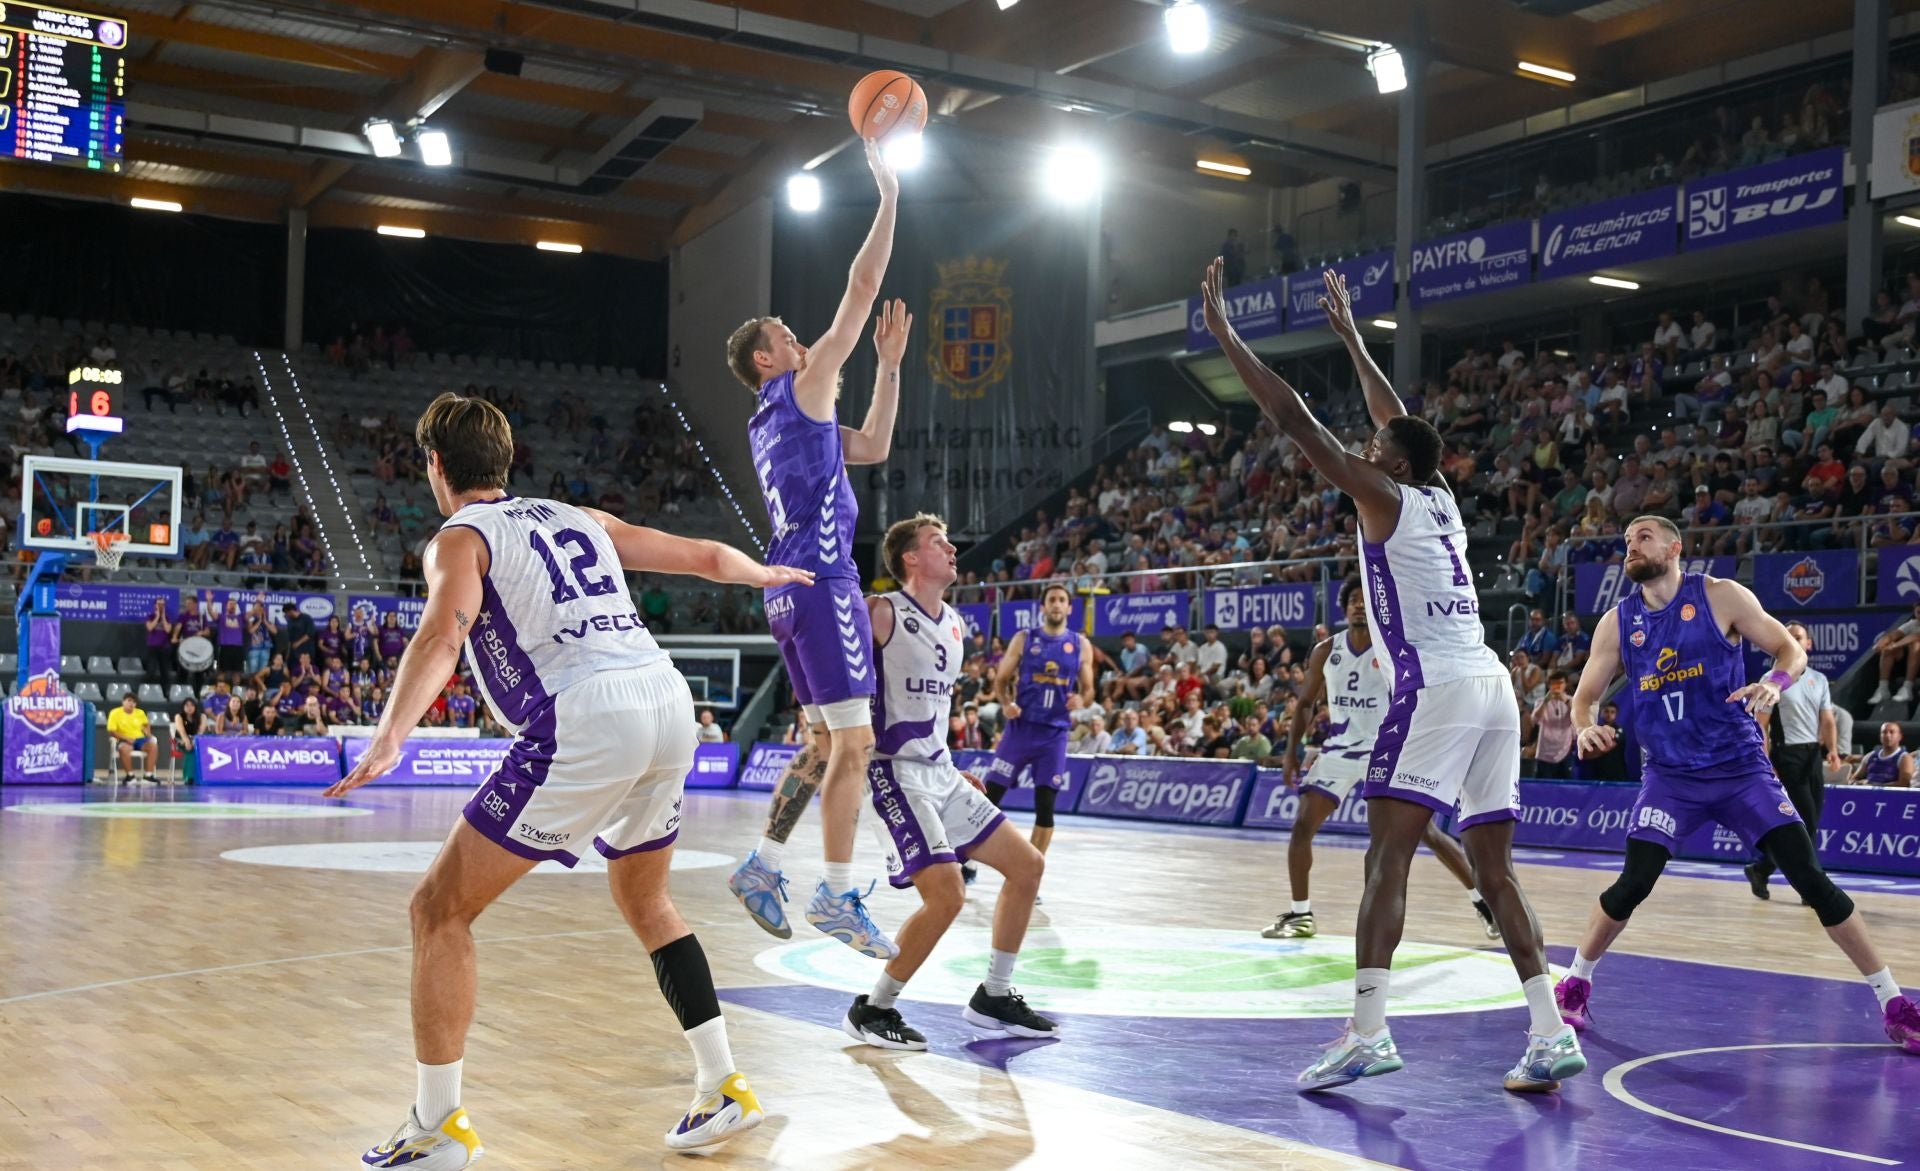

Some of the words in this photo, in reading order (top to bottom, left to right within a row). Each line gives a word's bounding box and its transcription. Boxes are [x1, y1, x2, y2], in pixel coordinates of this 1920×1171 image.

[1736, 168, 1833, 198] Transportes
[1731, 187, 1838, 225] BUJ
[1569, 206, 1672, 241] NEUMÁTICOS
[1562, 230, 1642, 258] PALENCIA
[1419, 280, 1467, 298] Transporte
[1469, 276, 1481, 289] de
[91, 390, 111, 417] 6
[760, 459, 787, 532] 5
[529, 527, 619, 605] 12
[1439, 534, 1469, 587] 1
[1785, 576, 1822, 588] PALENCIA
[1242, 591, 1304, 623] PETKUS
[485, 628, 522, 689] aspasia
[935, 643, 947, 672] 3
[1347, 671, 1360, 691] 2
[1640, 662, 1704, 692] agropal
[13, 695, 75, 713] PALENCIA
[1043, 689, 1055, 708] 11
[1661, 691, 1684, 722] 17
[16, 752, 69, 769] PALENCIA
[22, 741, 60, 758] JUEGA
[243, 749, 336, 765] ARAMBOL
[1369, 767, 1388, 778] CBC
[483, 790, 510, 817] CBC
[1118, 778, 1242, 814] agropal
[1638, 807, 1677, 835] gaza
